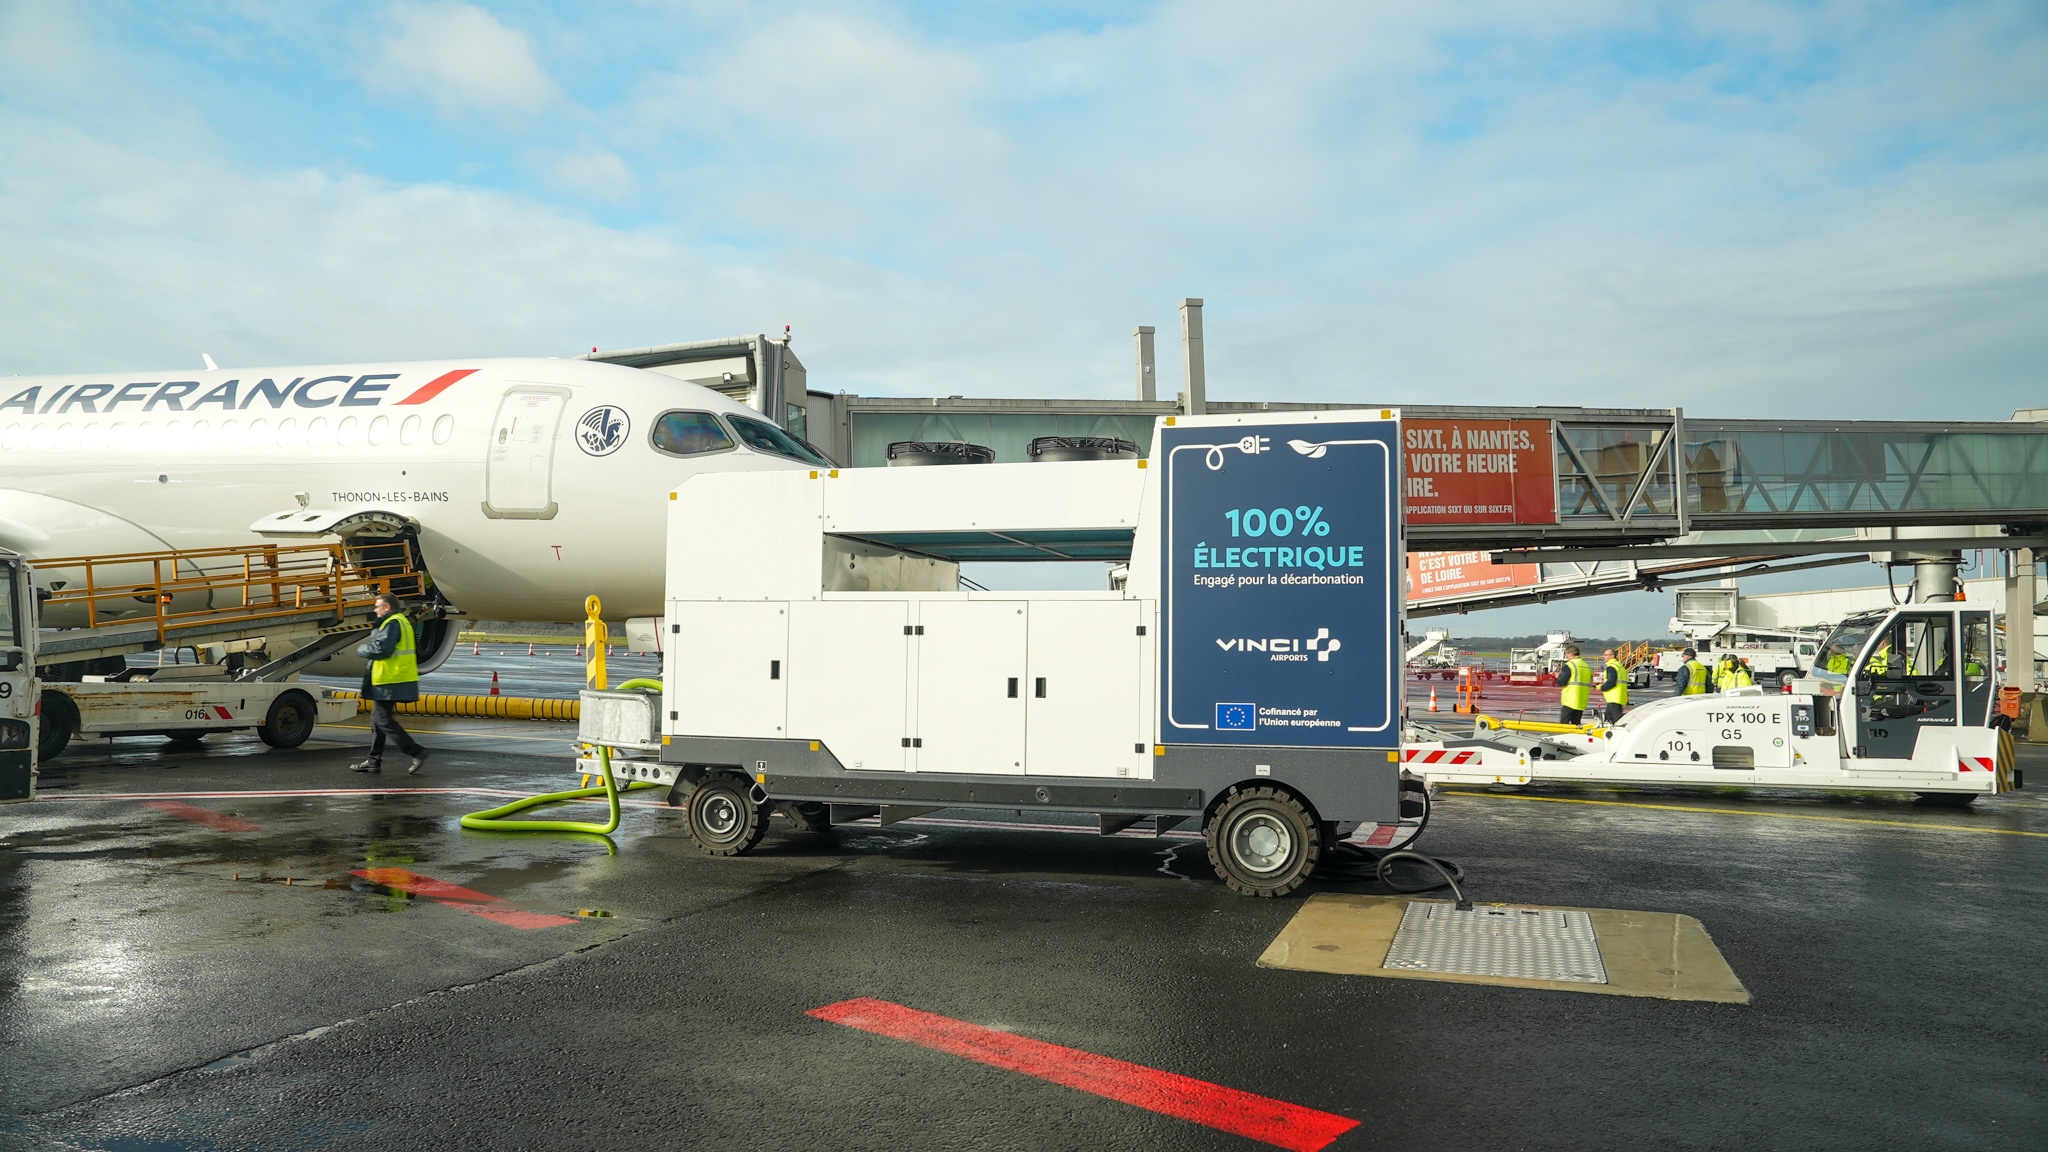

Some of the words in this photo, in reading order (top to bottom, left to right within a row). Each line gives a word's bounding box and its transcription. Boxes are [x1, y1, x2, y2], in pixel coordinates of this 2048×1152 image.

[0, 373, 401, 414] AIRFRANCE
[1406, 429, 1447, 451] SIXT,
[1451, 425, 1463, 449] À
[1466, 430, 1535, 451] NANTES,
[1411, 453, 1462, 473] VOTRE
[1466, 453, 1518, 473] HEURE
[1406, 477, 1439, 498] IRE.
[331, 491, 449, 502] THONON-LES-BAINS
[1403, 505, 1446, 514] APPLICATION
[1448, 505, 1462, 514] SIXT
[1463, 505, 1473, 514] OU
[1474, 505, 1487, 514] SUR
[1488, 505, 1513, 514] SIXT.FR
[1224, 505, 1331, 538] 100%
[1194, 541, 1364, 571] ÉLECTRIQUE
[1419, 556, 1446, 571] C'EST
[1448, 552, 1479, 567] VOTRE
[1193, 573, 1235, 588] Engagé
[1238, 575, 1265, 588] pour
[1267, 573, 1278, 585] la
[1280, 573, 1364, 585] décarbonation
[1421, 572, 1434, 584] DE
[1435, 568, 1465, 582] LOIRE.
[1215, 638, 1299, 652] VINCI
[1270, 654, 1309, 662] AIRPORTS
[185, 709, 205, 720] 016
[1259, 707, 1301, 716] Cofinancé
[1303, 709, 1318, 718] par
[1706, 712, 1735, 723] TPX
[1740, 712, 1766, 724] 100
[1772, 713, 1781, 724] E
[1259, 718, 1289, 726] l'Union
[1290, 719, 1341, 728] européenne
[1721, 728, 1742, 740] G5
[1667, 740, 1692, 751] 101
